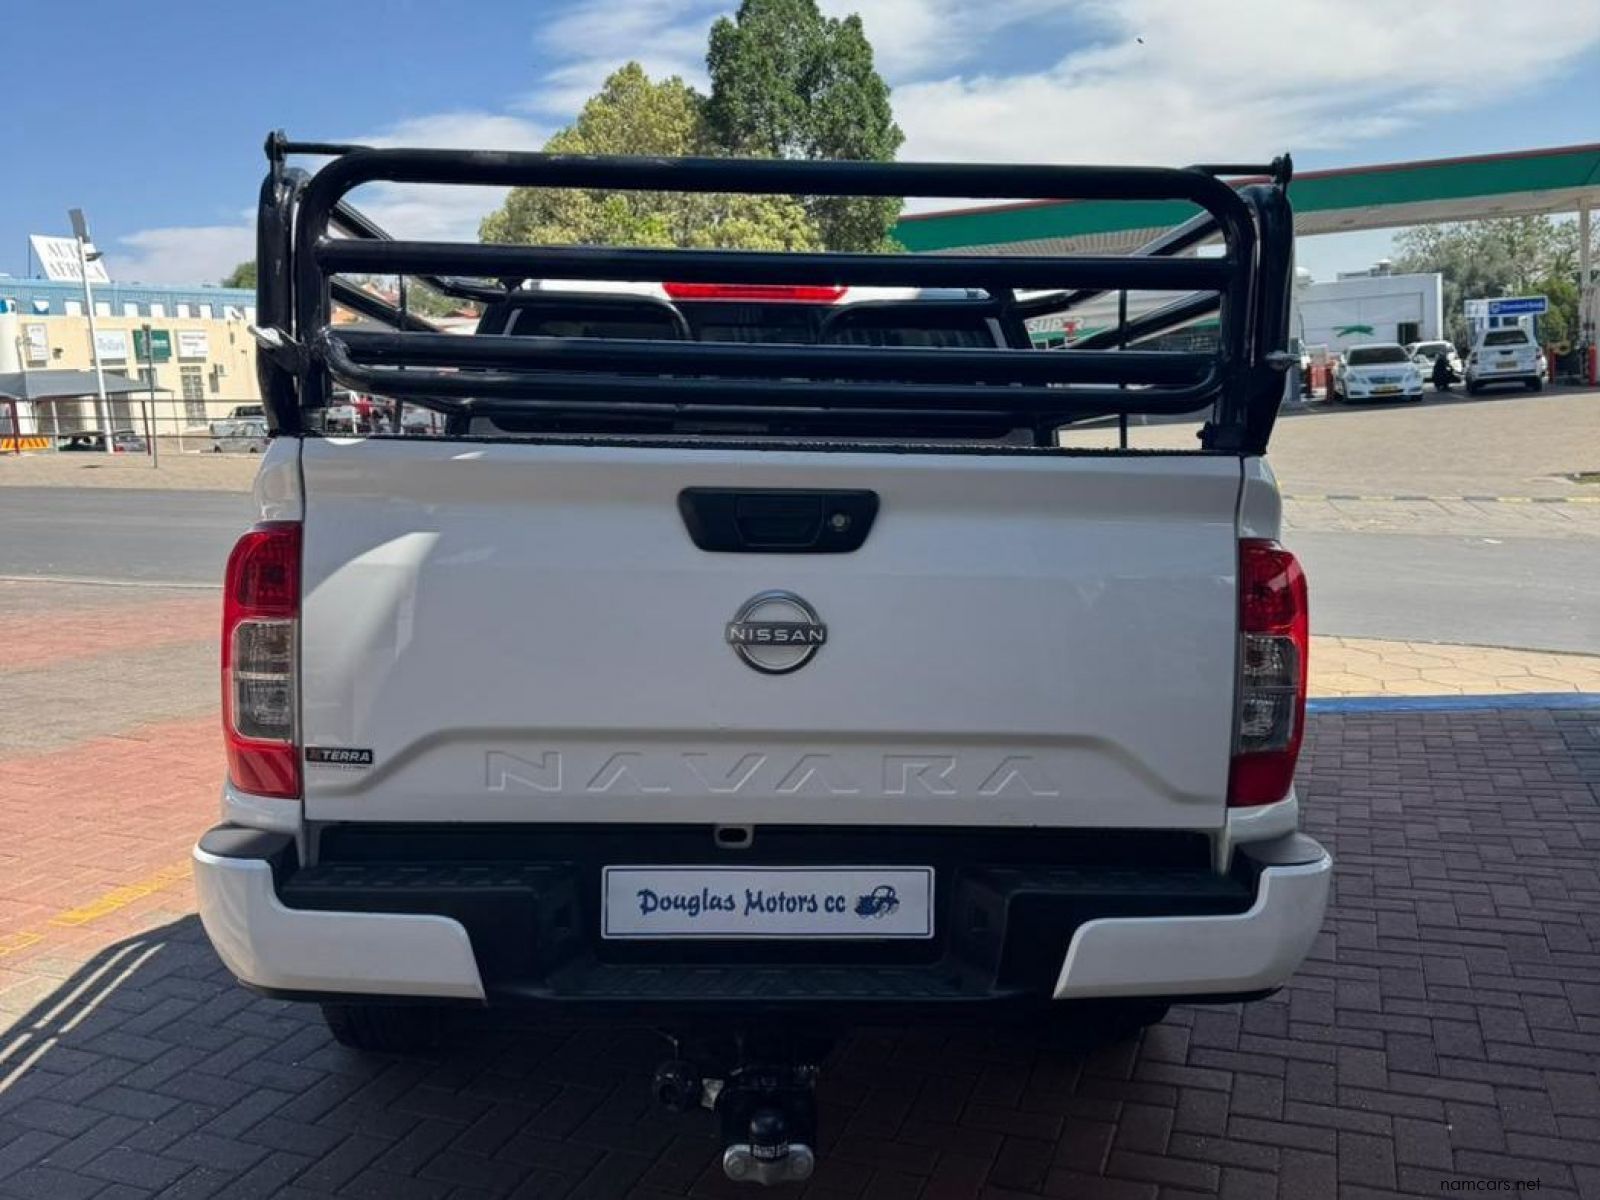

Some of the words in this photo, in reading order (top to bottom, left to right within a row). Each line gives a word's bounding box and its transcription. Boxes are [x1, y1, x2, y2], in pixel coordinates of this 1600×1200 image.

[46, 241, 82, 257] AUT
[49, 260, 106, 279] AFRIA
[730, 626, 823, 641] NISSAN
[485, 751, 1061, 796] NAVARA
[637, 887, 735, 917] Douglas
[744, 889, 818, 916] Motors
[824, 895, 845, 912] cc
